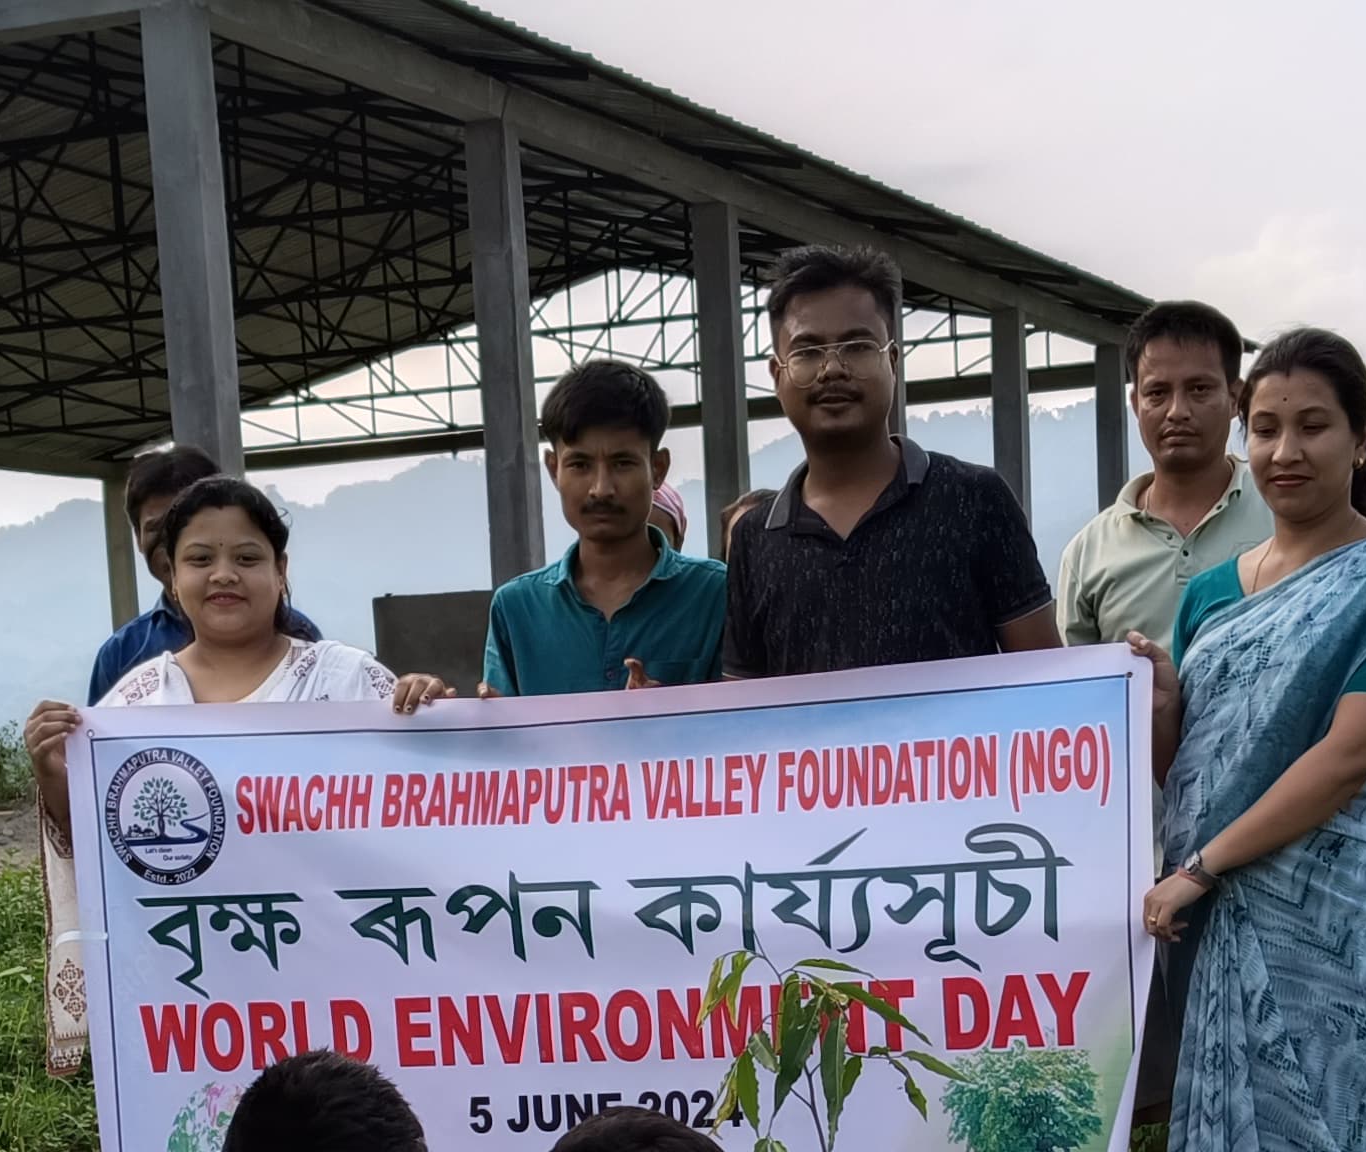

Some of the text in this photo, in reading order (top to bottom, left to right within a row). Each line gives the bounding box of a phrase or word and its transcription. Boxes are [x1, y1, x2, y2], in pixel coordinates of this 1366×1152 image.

[107, 750, 225, 864] SWACHH BRAHMAPUTRA VALLEY FOUNDATION
[237, 725, 1110, 834] SWACHH BRAHMAPUTRA VALLEY FOUNDATION (NGO)
[174, 867, 197, 883] 2022
[135, 892, 304, 999] বৃক্ষ
[139, 999, 373, 1073] WORLD
[942, 970, 1091, 1050] DAY
[469, 1096, 493, 1134] 5
